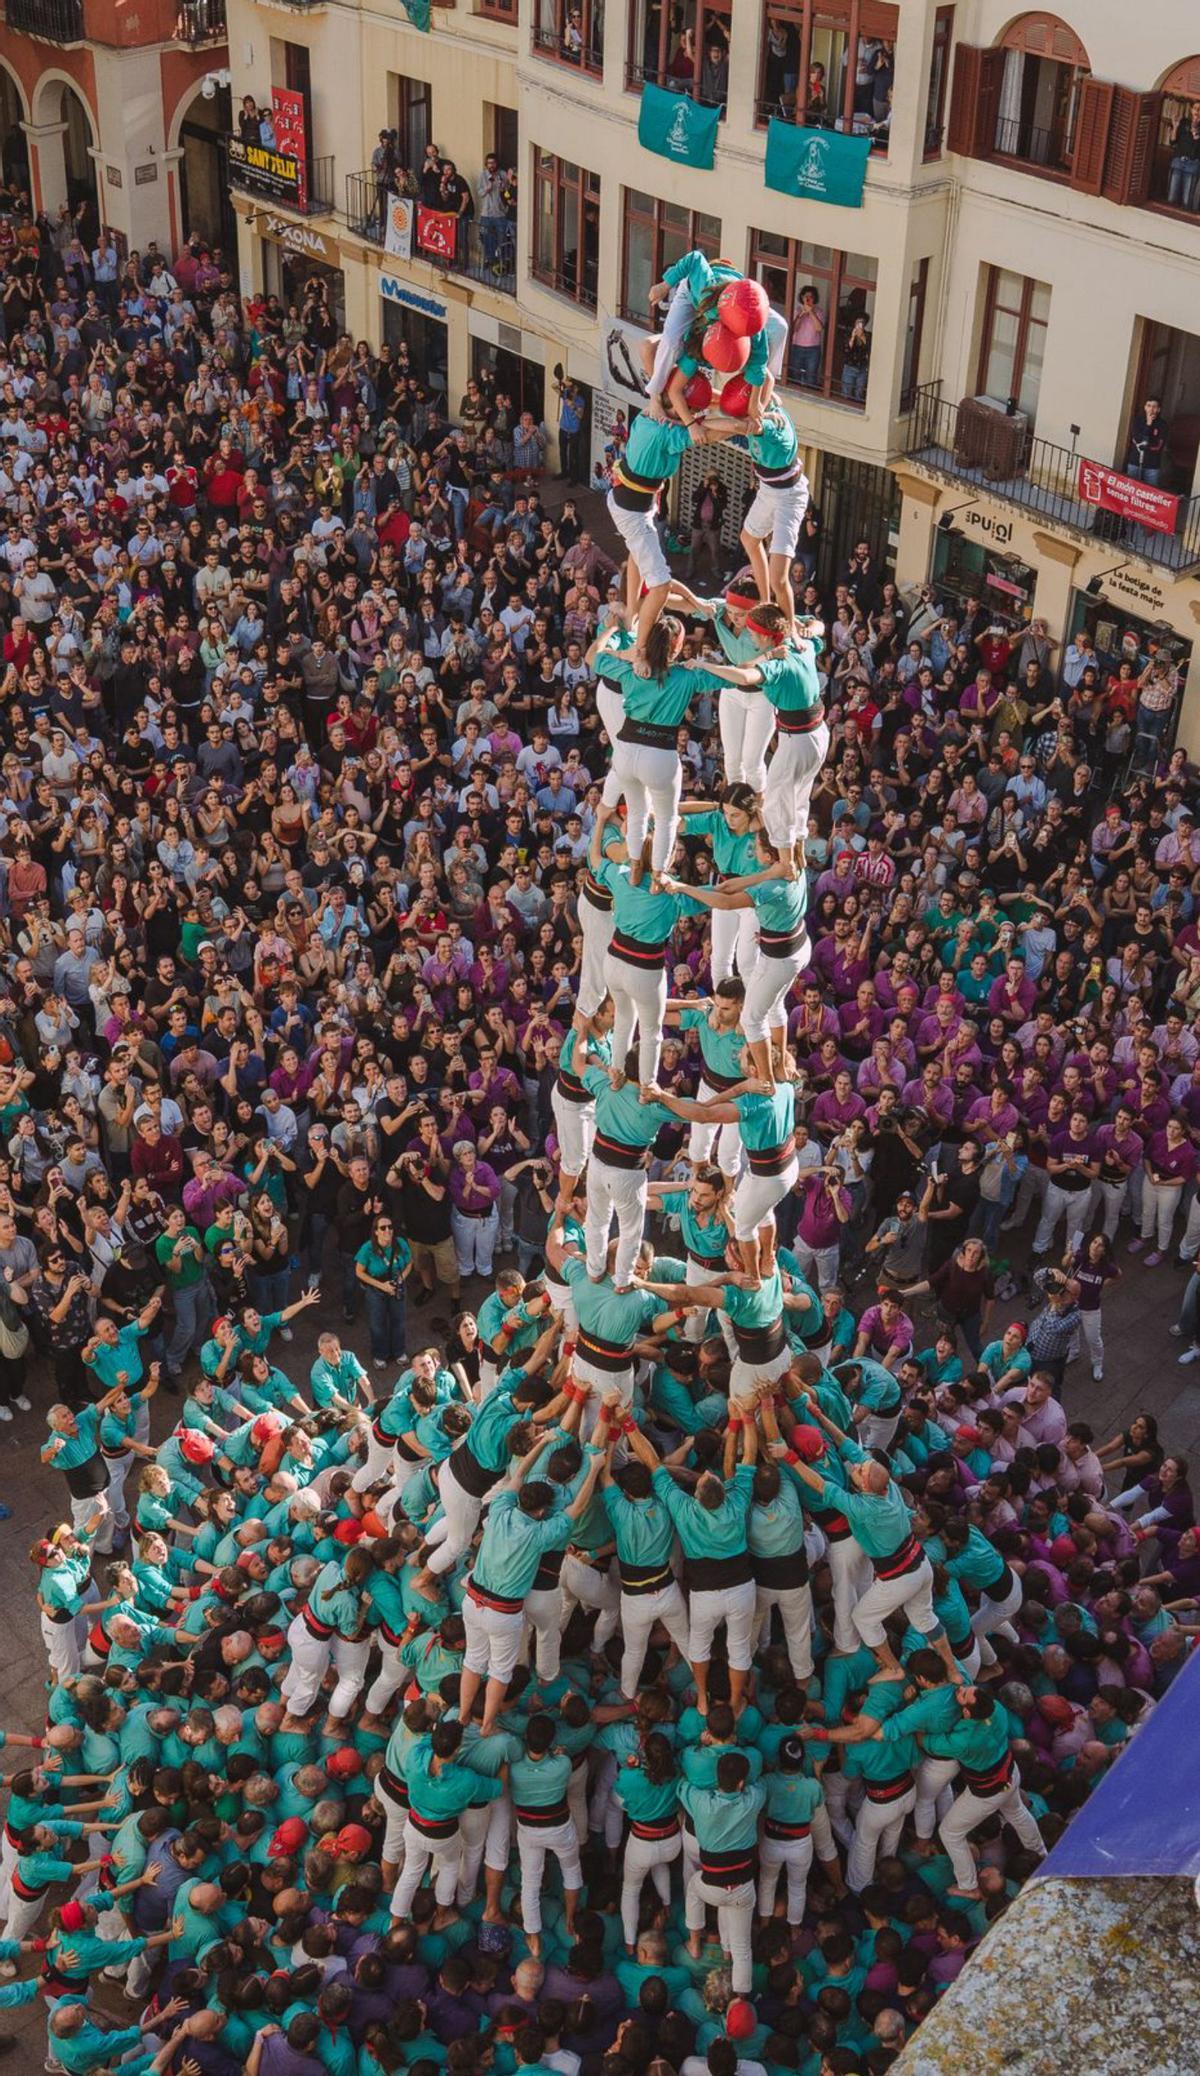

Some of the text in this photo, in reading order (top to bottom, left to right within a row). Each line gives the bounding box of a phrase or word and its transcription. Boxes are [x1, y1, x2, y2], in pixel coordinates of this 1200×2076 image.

[247, 145, 270, 170] SANT
[1135, 488, 1172, 508] casteller
[1113, 569, 1162, 596] La botiga de
[1118, 582, 1139, 598] festa
[1139, 593, 1165, 611] major
